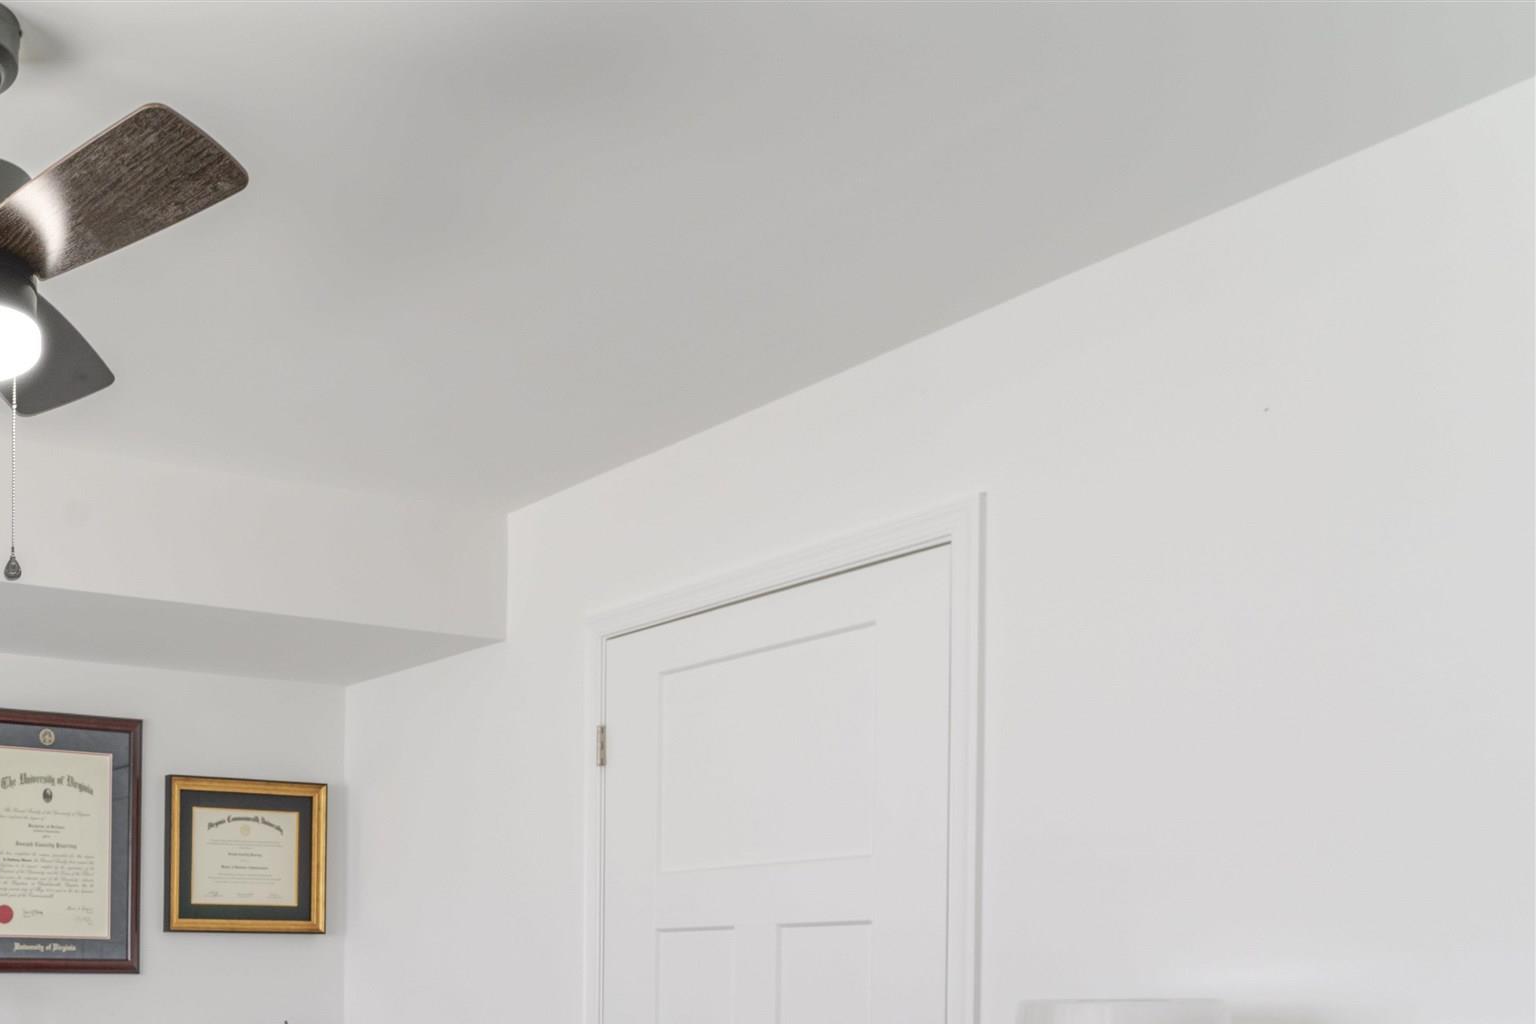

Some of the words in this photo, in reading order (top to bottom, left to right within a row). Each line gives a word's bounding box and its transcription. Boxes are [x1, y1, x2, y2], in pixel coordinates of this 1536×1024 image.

[0, 776, 16, 790] The
[19, 772, 55, 787] University
[56, 775, 64, 785] of
[66, 774, 94, 796] Virginia
[13, 942, 44, 952] University
[52, 943, 77, 953] Virginia
